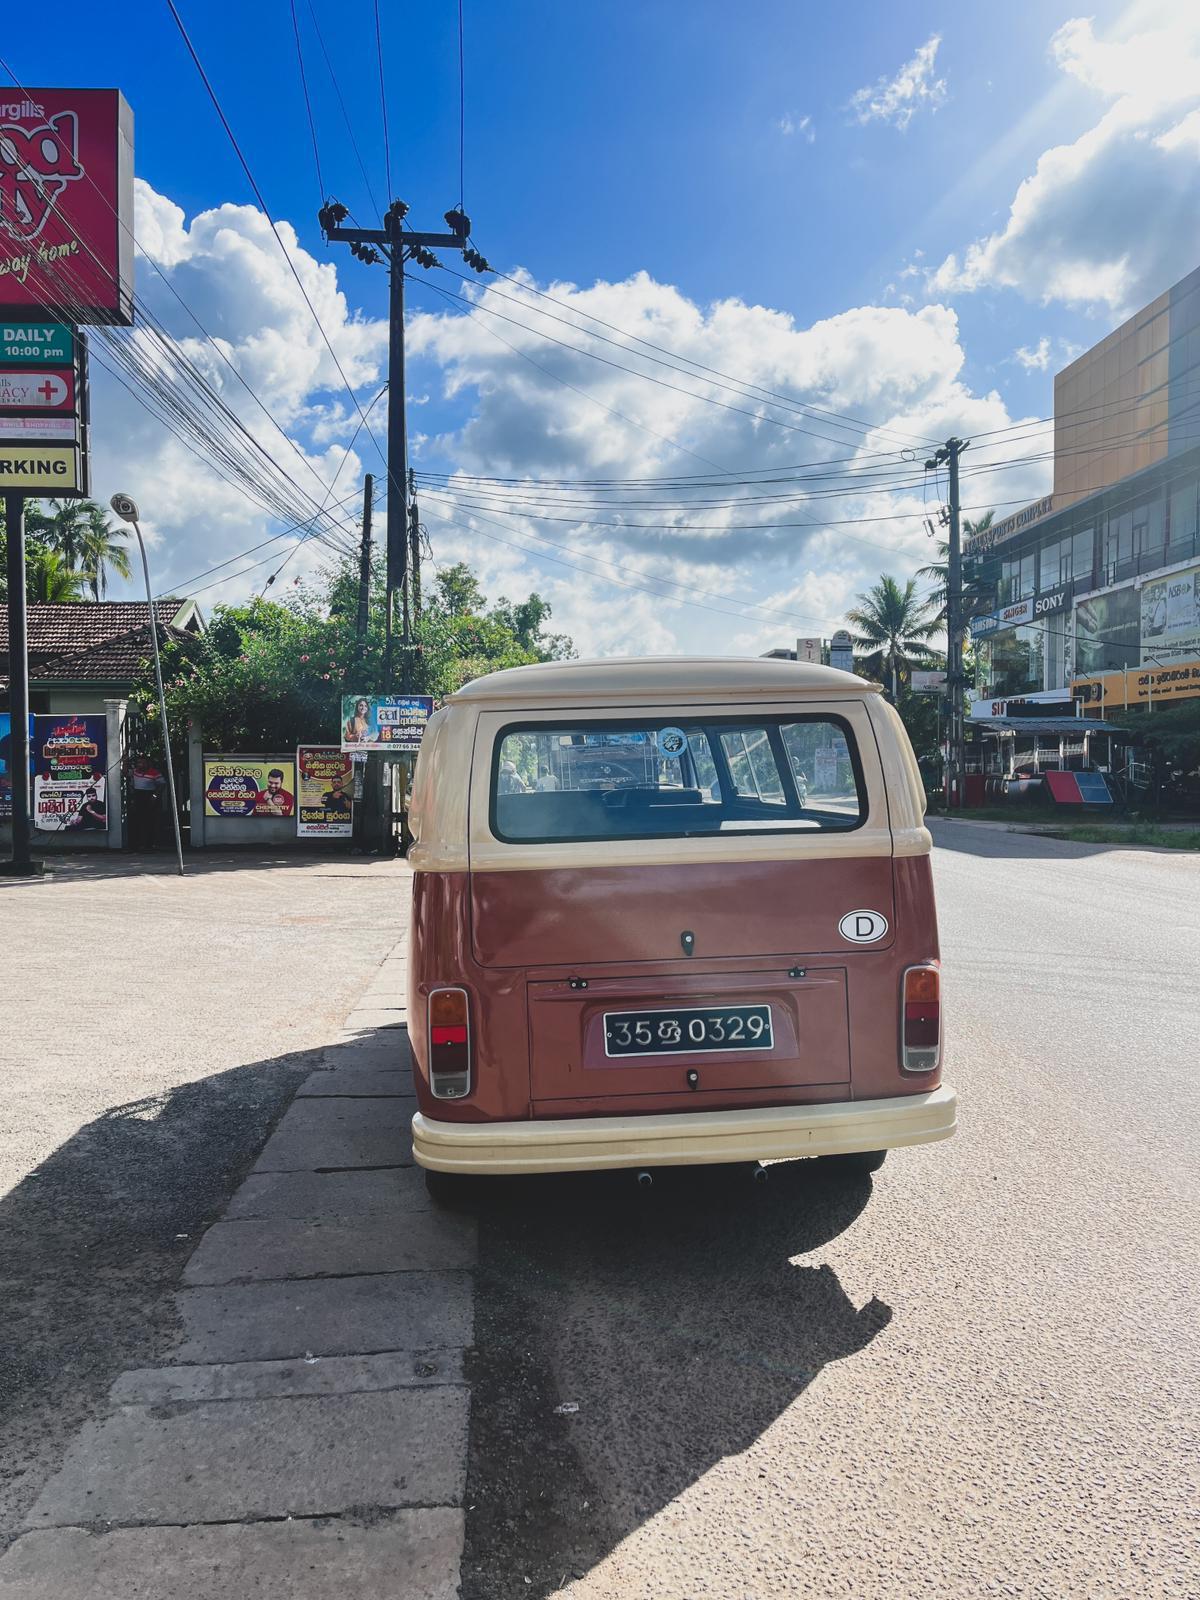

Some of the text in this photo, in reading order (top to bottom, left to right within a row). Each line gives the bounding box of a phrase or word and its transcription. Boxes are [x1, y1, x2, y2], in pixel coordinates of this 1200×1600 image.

[0, 101, 44, 120] rgills
[39, 240, 79, 262] home
[3, 329, 56, 341] DAILY
[5, 347, 64, 358] 10:00 pm
[0, 387, 29, 397] ACY
[0, 460, 67, 474] RKING
[1003, 603, 1028, 620] SINGER
[1035, 592, 1065, 614] SONY
[855, 916, 875, 937] D
[614, 1020, 652, 1046] 35
[688, 1015, 765, 1043] 0329
